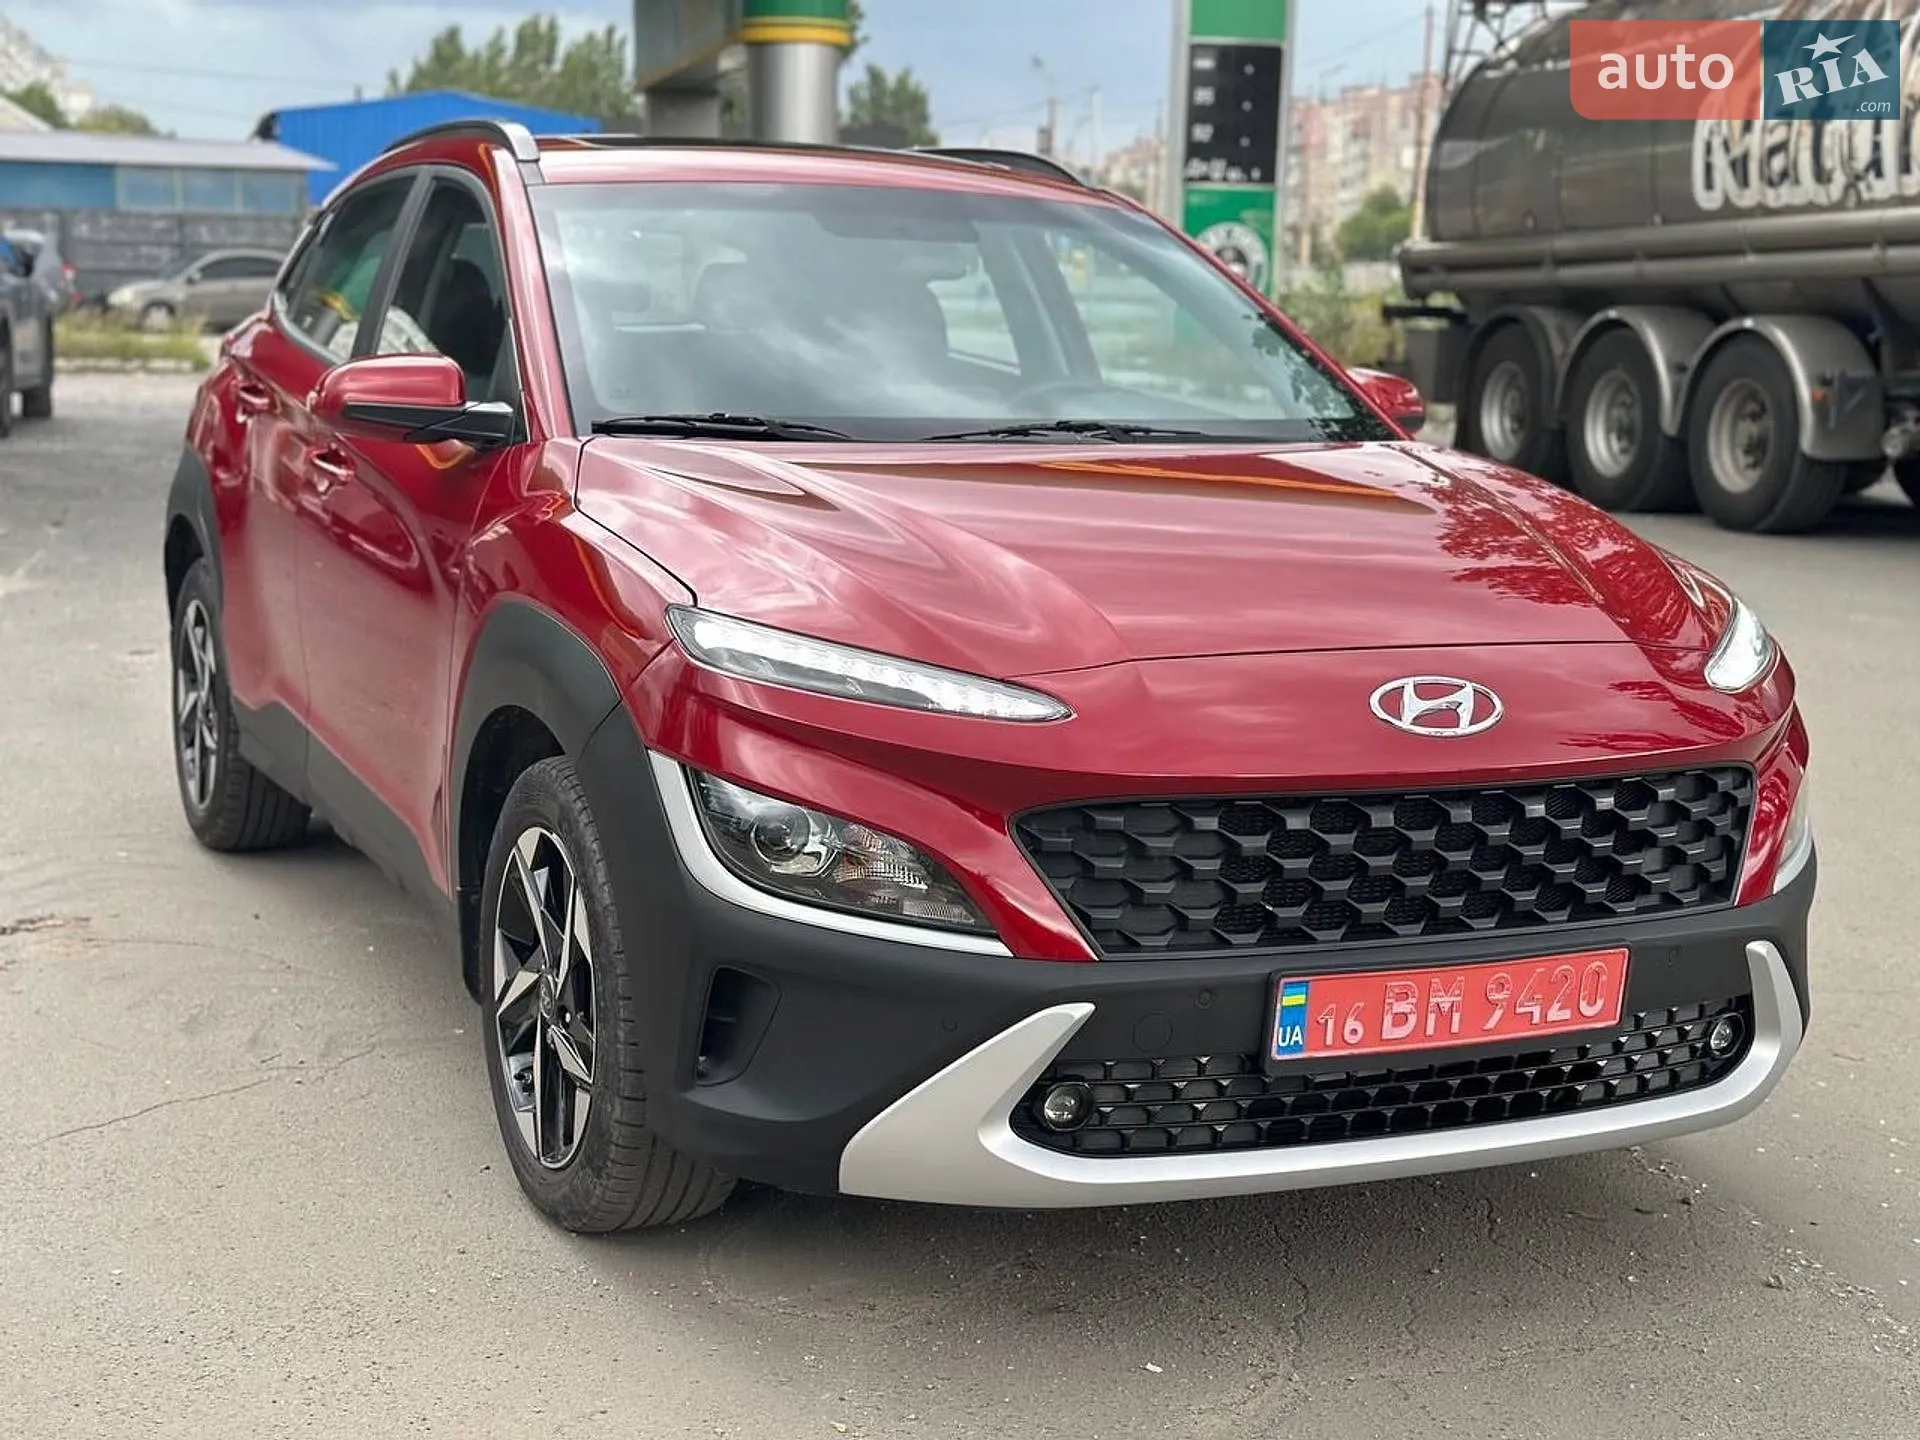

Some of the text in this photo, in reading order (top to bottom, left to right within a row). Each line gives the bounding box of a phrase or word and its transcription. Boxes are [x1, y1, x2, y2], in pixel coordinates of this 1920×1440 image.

[1316, 960, 1609, 1046] 16 BM 9420
[1277, 1024, 1303, 1047] UA
